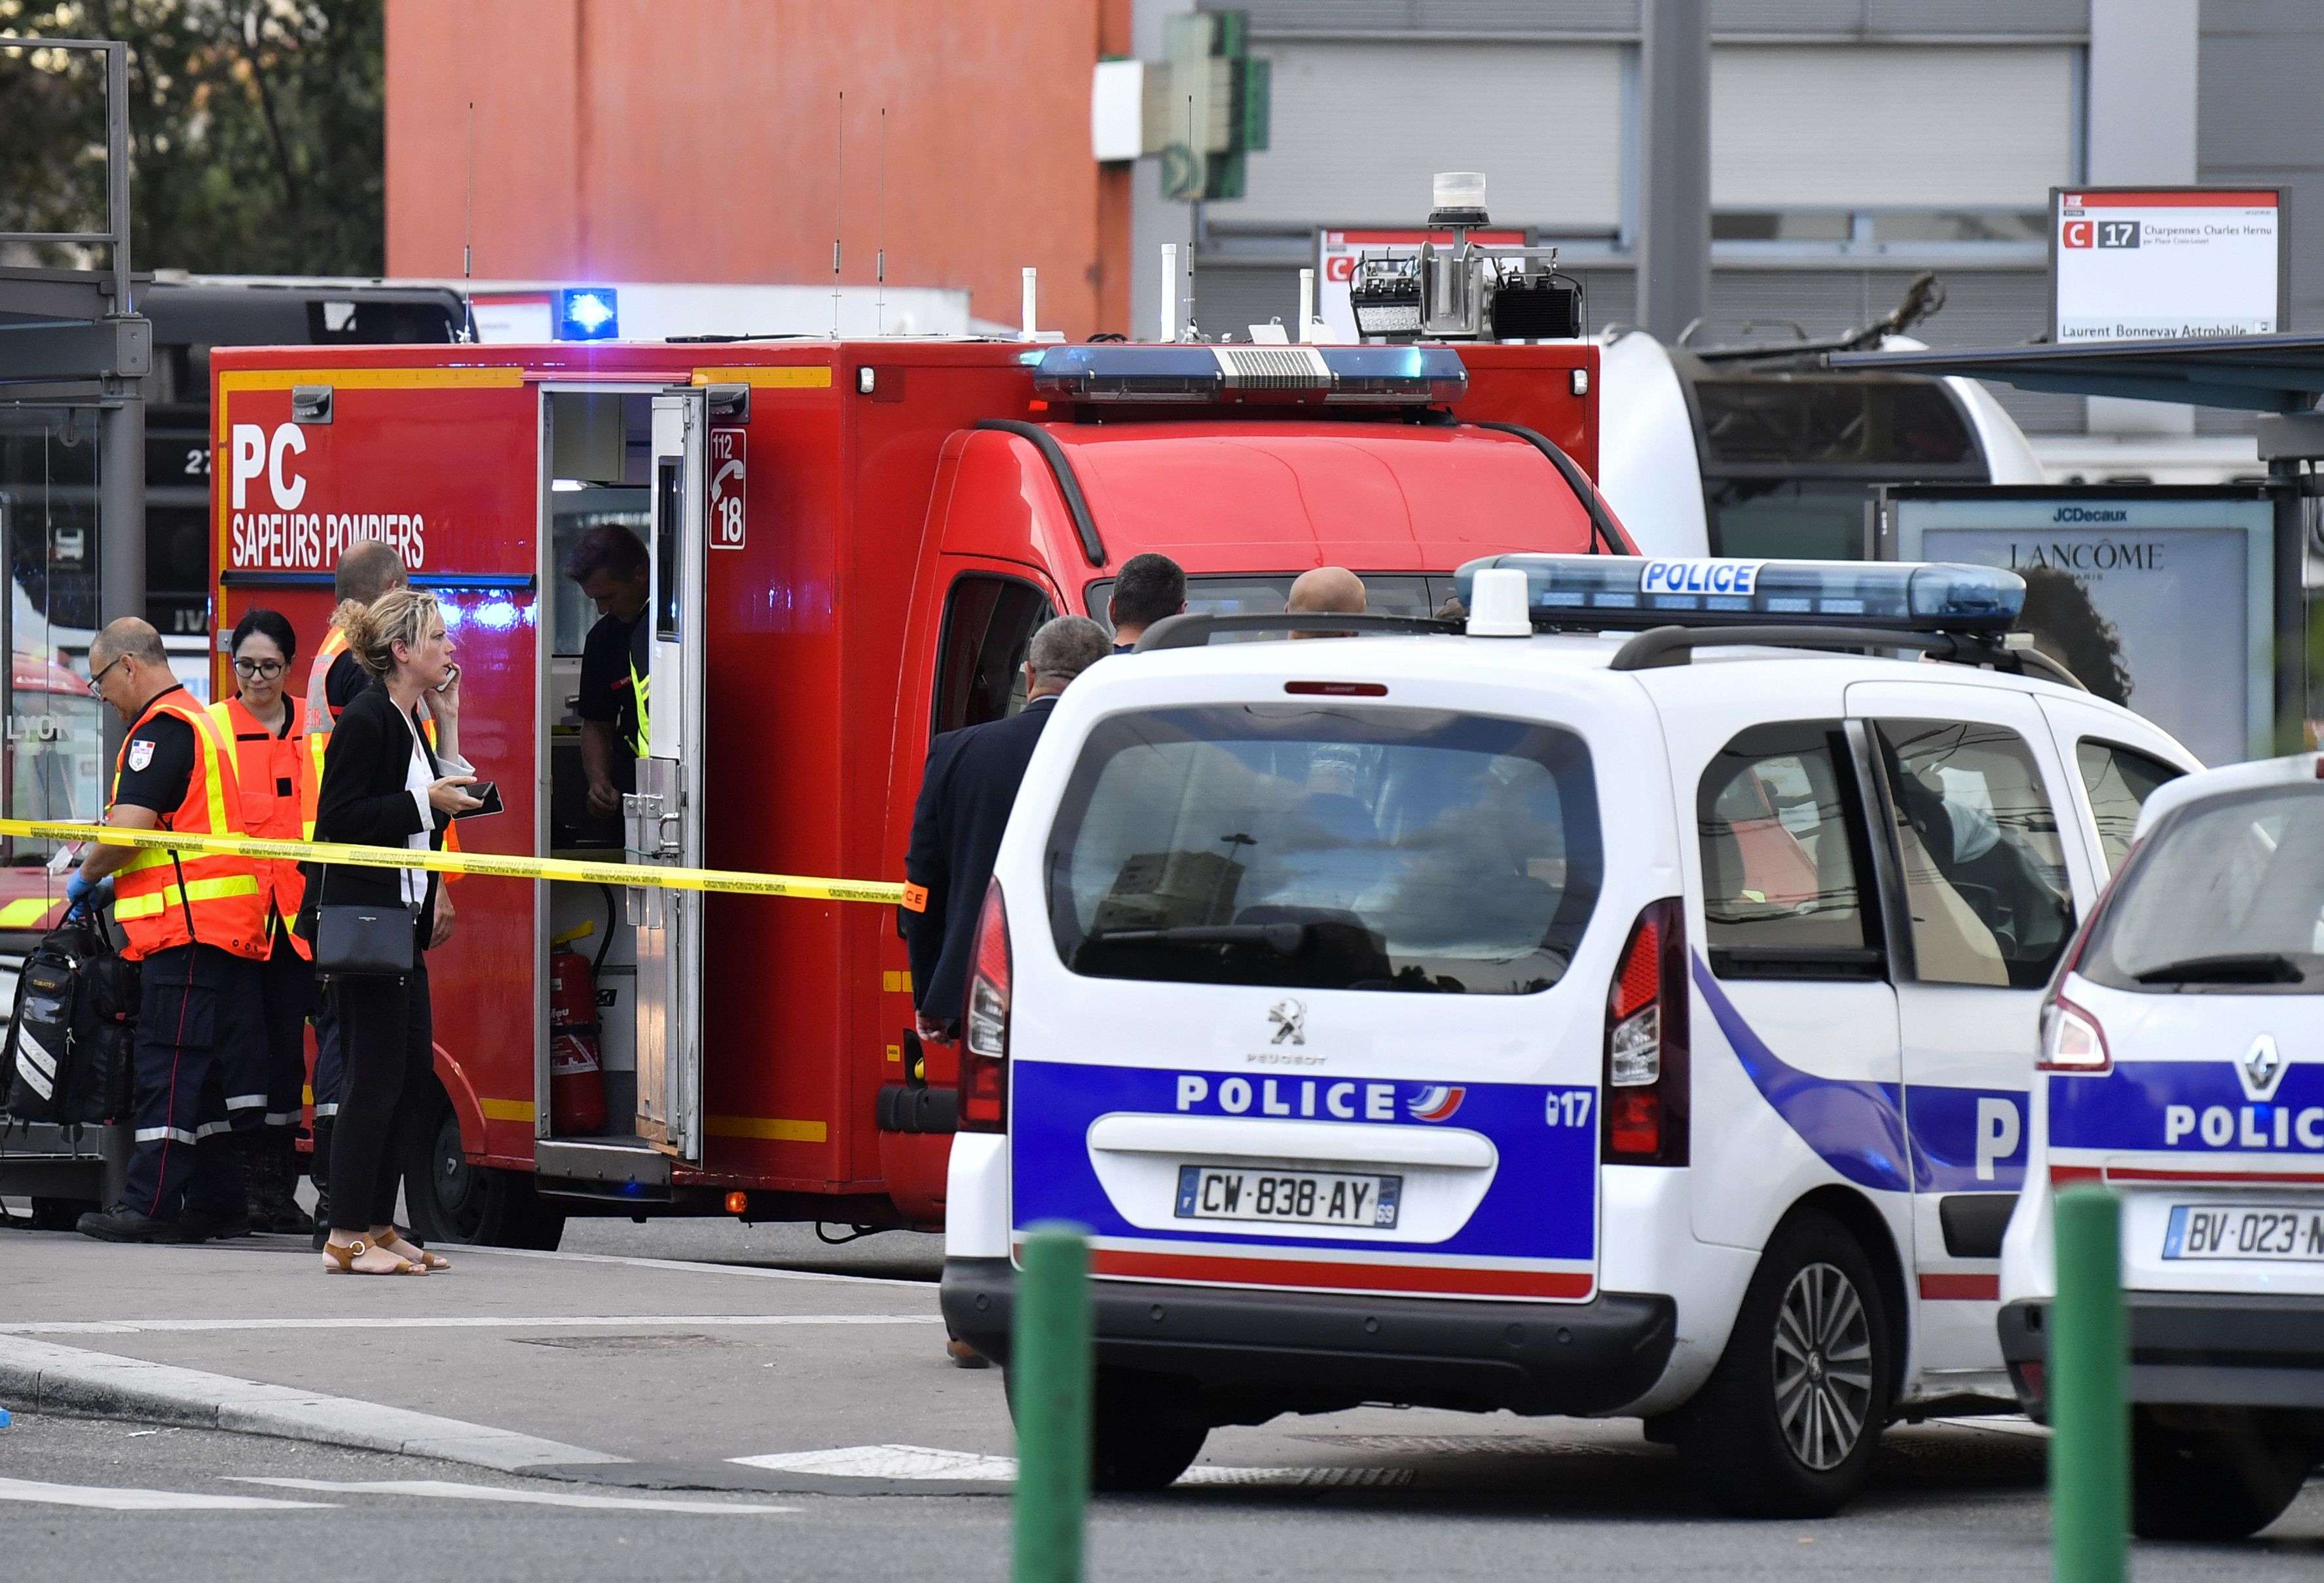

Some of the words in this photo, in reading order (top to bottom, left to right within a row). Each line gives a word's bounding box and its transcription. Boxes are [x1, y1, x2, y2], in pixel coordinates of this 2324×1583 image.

[2069, 223, 2085, 246] C
[2105, 223, 2133, 246] 17
[2145, 225, 2200, 236] Charpennes
[2204, 225, 2240, 235] Charles
[2243, 225, 2272, 235] Hernu
[1333, 258, 1348, 280] C
[2063, 325, 2110, 337] Laurent
[2116, 325, 2177, 339] Bonnevay
[713, 434, 733, 459] 112
[232, 422, 306, 510] PC
[718, 496, 742, 542] 18
[2054, 508, 2128, 522] JCDecaux
[232, 513, 320, 568] SAPEURS
[2011, 538, 2164, 570] LANCÔME
[1647, 563, 1756, 592] POLICE
[175, 610, 210, 631] IV
[1247, 1053, 1327, 1066] PEUGEOT
[1177, 1075, 1396, 1121] POLICE
[1560, 1090, 1593, 1128] 17
[1203, 1174, 1370, 1220] CW-838-AY
[1376, 1204, 1395, 1223] 69
